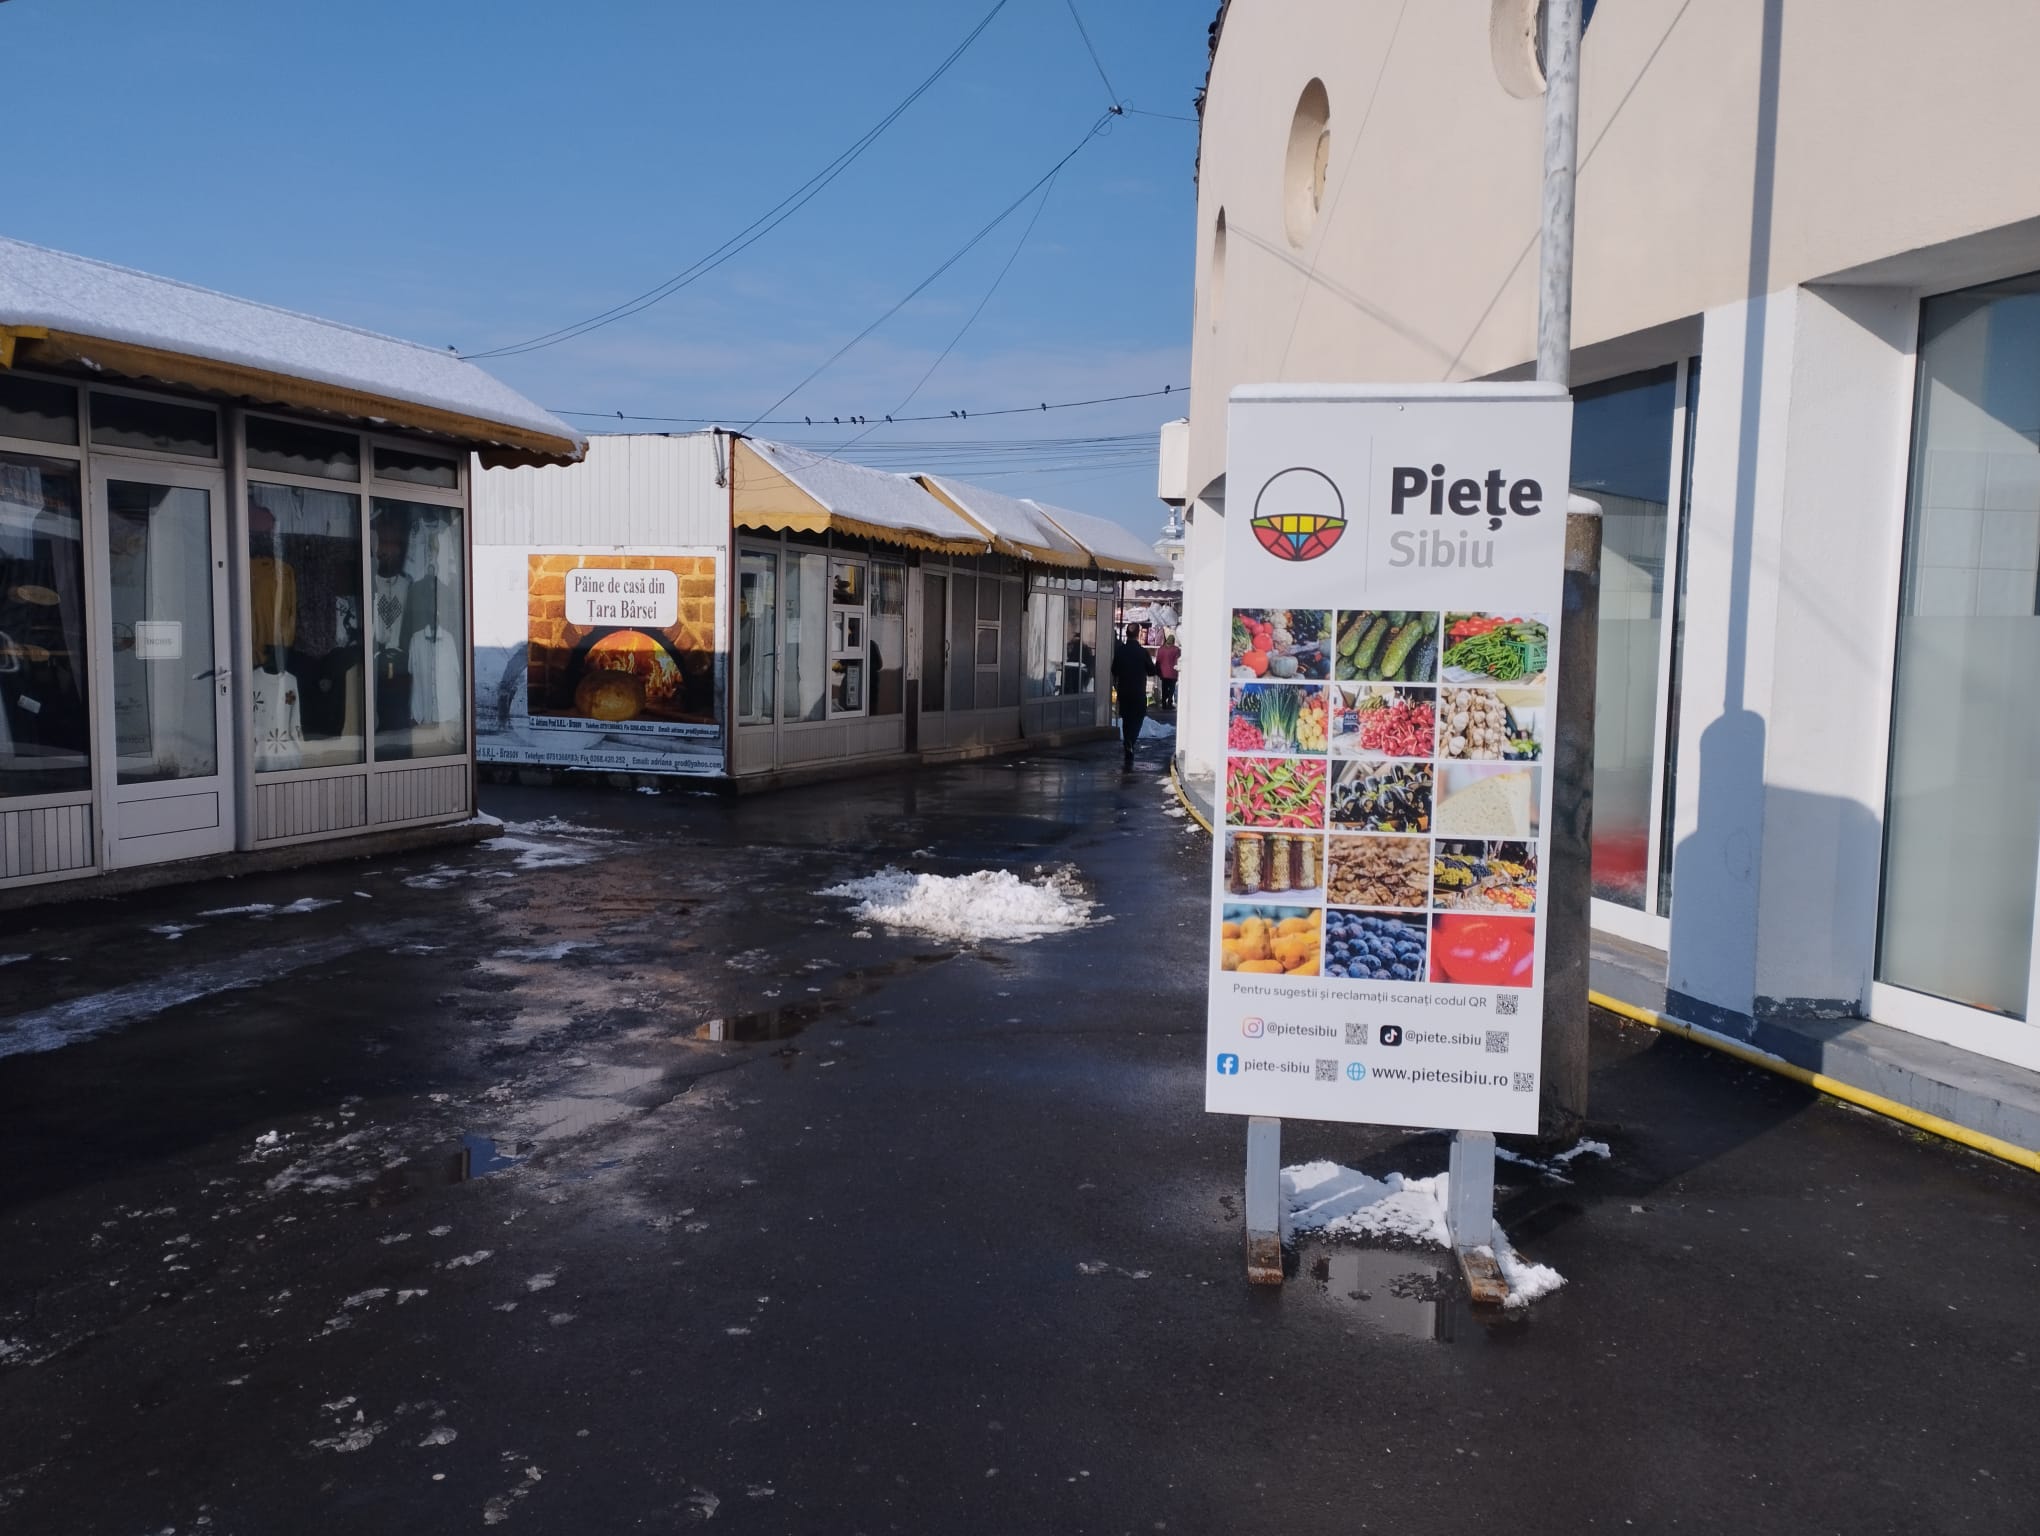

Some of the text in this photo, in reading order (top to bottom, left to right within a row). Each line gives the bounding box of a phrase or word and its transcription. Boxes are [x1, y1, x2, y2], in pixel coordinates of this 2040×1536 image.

[1391, 463, 1543, 532] Piețe
[1388, 529, 1494, 569] Sibiu
[574, 575, 665, 594] Pâine de casă din
[587, 599, 657, 622] Țara Bârsei
[1233, 983, 1487, 1008] Pentru sugestii și reclamații scanați codul QR
[1266, 1021, 1338, 1038] @pietesibiu
[1405, 1029, 1482, 1046] @piete.sibiu
[1244, 1058, 1310, 1074] piete-sibiu
[1372, 1066, 1508, 1087] www.pietesibiu.ro
